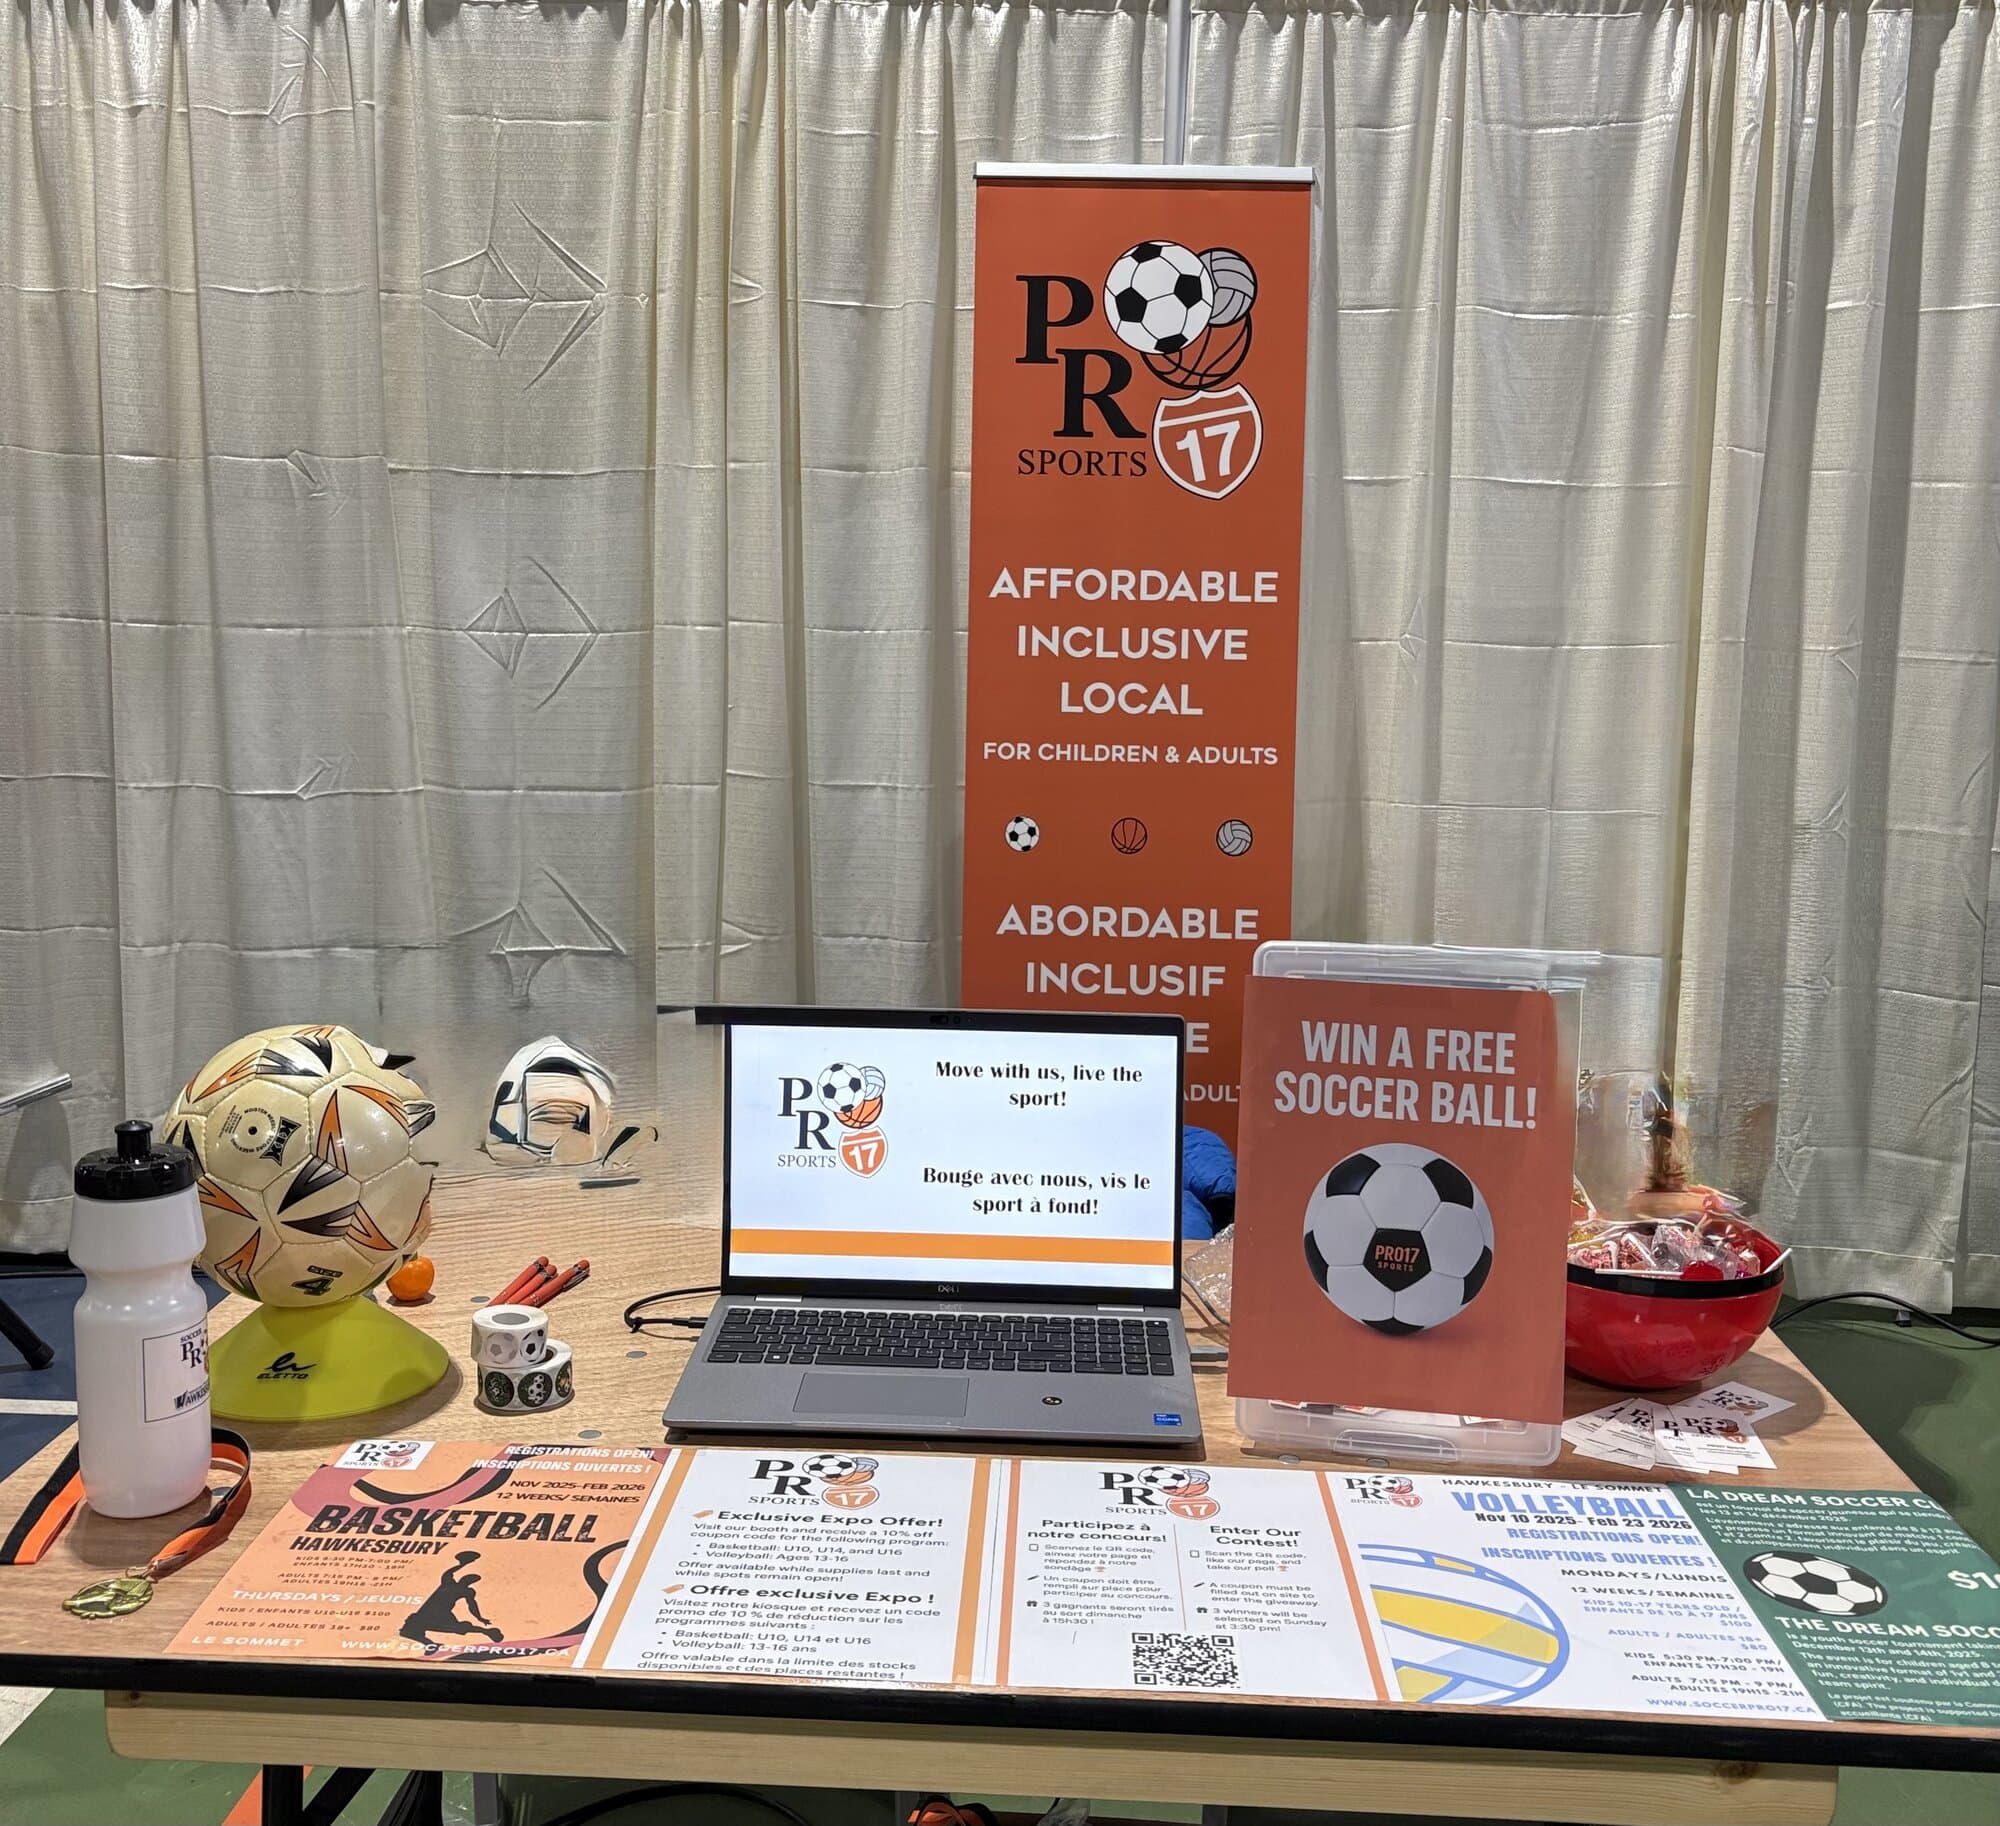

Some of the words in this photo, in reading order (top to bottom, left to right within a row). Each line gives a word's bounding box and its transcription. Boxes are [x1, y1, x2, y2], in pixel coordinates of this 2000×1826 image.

[1018, 449, 1146, 477] SPORTS
[1176, 420, 1241, 482] 17
[989, 567, 1278, 603] AFFORDABLE
[1018, 625, 1248, 661] INCLUSIVE
[1061, 682, 1203, 715] LOCAL
[984, 743, 1031, 761] FOR
[1038, 743, 1158, 763] CHILDREN
[1165, 747, 1179, 763] &
[1187, 746, 1277, 765] ADULTS
[997, 904, 1258, 940] ABORDABLE
[1026, 962, 1225, 996] INCLUSIF
[1302, 1020, 1376, 1065] WIN
[1388, 1027, 1413, 1069] A
[1426, 1029, 1515, 1075] FREE
[936, 1062, 983, 1078] Move
[991, 1063, 1029, 1079] with
[1038, 1066, 1065, 1081] us,
[1073, 1065, 1105, 1081] live
[1113, 1066, 1142, 1082] the
[1009, 1091, 1066, 1108] sport!
[1274, 1071, 1418, 1123] SOCCER
[1431, 1082, 1536, 1129] BALL!
[778, 1154, 836, 1168] SPORTS
[849, 1143, 878, 1172] 17
[923, 1168, 983, 1186] Bouge
[991, 1171, 1033, 1185] avec
[1041, 1174, 1093, 1189] nous,
[1100, 1173, 1126, 1188] vis
[1134, 1174, 1150, 1190] le
[973, 1197, 1022, 1214] sport
[1031, 1197, 1041, 1213] à
[1048, 1197, 1098, 1215] fond!
[1375, 1245, 1420, 1262] PRO17
[1378, 1262, 1414, 1272] SPORTS
[256, 1372, 309, 1380] ELETTO
[504, 1446, 610, 1459] REGISTRATIONS
[613, 1448, 655, 1459] OPEN!
[472, 1459, 570, 1472] INSCRIPTIONS
[573, 1461, 642, 1474] OUVERTES
[510, 1480, 542, 1489] NOV
[544, 1480, 608, 1490] 2025-FEB
[612, 1483, 646, 1491] 2026
[1442, 1479, 1553, 1490] HAWKESBURY
[1595, 1484, 1663, 1493] SOMMET
[495, 1492, 509, 1500] 12
[573, 1495, 641, 1504] SEMAINES
[748, 1496, 820, 1506] SPORTS
[835, 1492, 869, 1506] 17
[1452, 1491, 1686, 1519] VOLLEYBALL
[1687, 1488, 1719, 1500] LA
[1722, 1491, 1808, 1506] DREAM
[1812, 1496, 1910, 1508] SOCCER
[718, 1511, 814, 1523] Exclusive
[820, 1516, 874, 1526] Expo
[880, 1517, 943, 1527] Offer!
[1106, 1506, 1167, 1515] SPORTS
[1181, 1504, 1209, 1516] 17
[305, 1504, 601, 1543] BASKETBALL
[794, 1526, 817, 1534] and
[1042, 1520, 1135, 1531] Participez
[1141, 1523, 1151, 1531] à
[1475, 1512, 1506, 1523] Nov
[1512, 1514, 1529, 1524] 10
[1536, 1515, 1582, 1526] 2025-
[1588, 1517, 1618, 1527] Feb
[1623, 1519, 1644, 1528] 23
[1651, 1520, 1692, 1530] 2026
[691, 1532, 740, 1540] coupon
[826, 1536, 885, 1545] following
[1027, 1531, 1075, 1539] notre
[1080, 1533, 1167, 1542] concours!
[1210, 1526, 1260, 1536] Enter
[1266, 1528, 1301, 1537] Our
[1507, 1528, 1644, 1543] REGISTRATIONS
[1647, 1533, 1703, 1546] OPEN!
[289, 1536, 448, 1556] HAWKESBURY
[709, 1542, 781, 1551] Basketball:
[784, 1544, 812, 1553] U10,
[817, 1546, 846, 1555] U14,
[878, 1548, 902, 1556] U16
[1216, 1536, 1298, 1547] Contest!
[706, 1551, 773, 1560] Volleyball:
[776, 1554, 810, 1562] Ages
[1481, 1547, 1607, 1563] INSCRIPTIONS
[1611, 1553, 1704, 1567] OUVERTES
[231, 1591, 343, 1602] THURSDAYS
[356, 1595, 424, 1605] JEUDIS
[690, 1584, 749, 1597] Offre
[756, 1588, 858, 1601] exclusive
[866, 1592, 921, 1604] Expo
[1775, 1616, 1829, 1631] THE
[1832, 1620, 1930, 1637] DREAM
[192, 1636, 214, 1644] LE
[223, 1636, 304, 1647] SOMMET
[1792, 1641, 1856, 1653] December
[1859, 1646, 1885, 1655] 13th
[1889, 1648, 1912, 1656] and
[1948, 1650, 1984, 1659] 2025.
